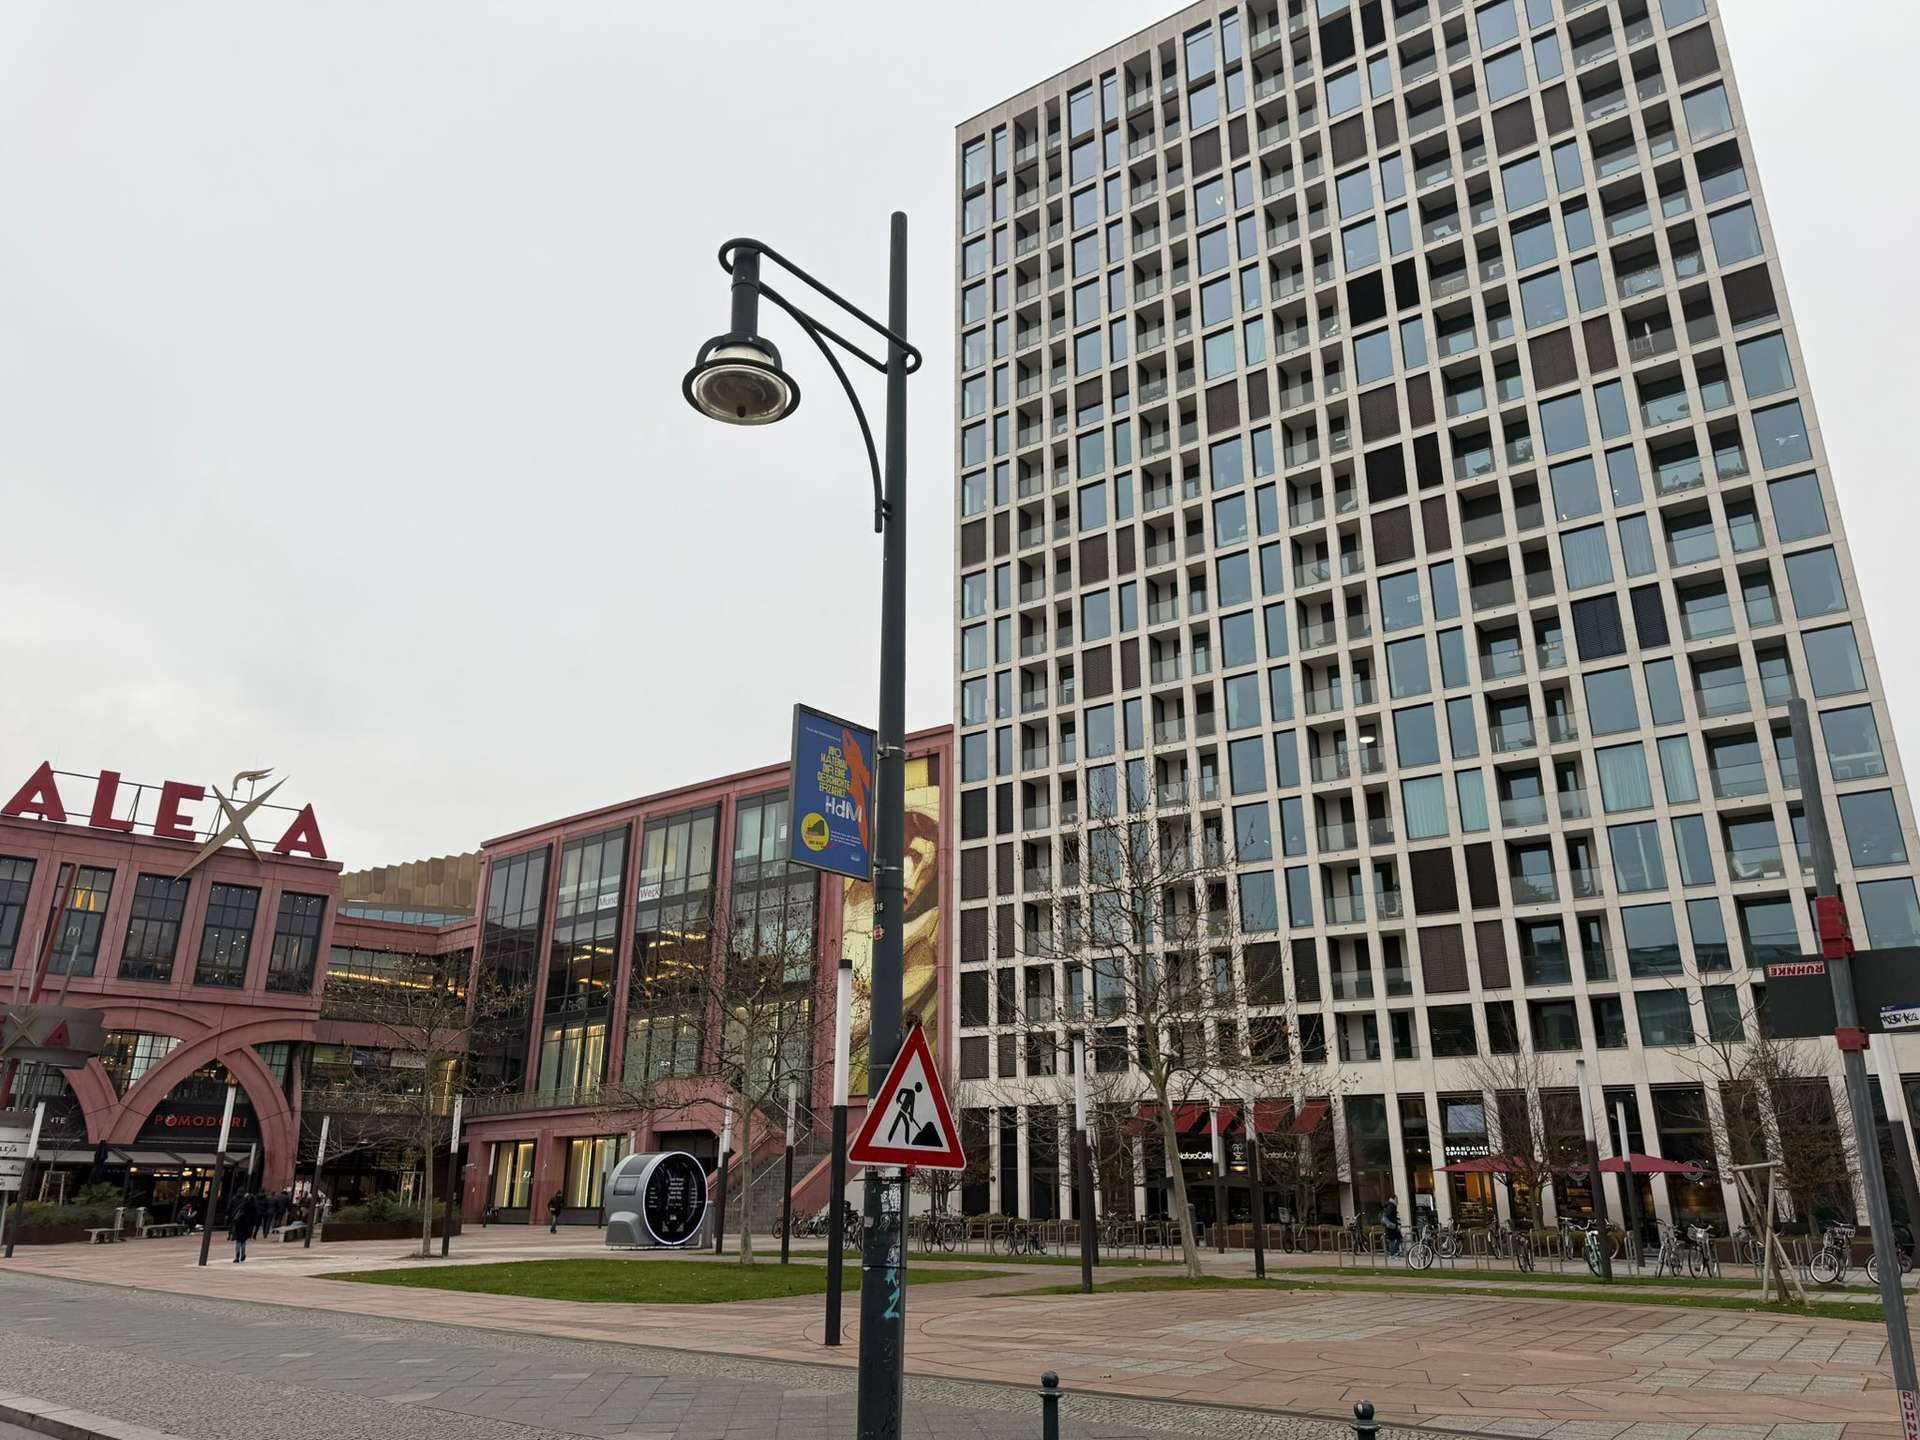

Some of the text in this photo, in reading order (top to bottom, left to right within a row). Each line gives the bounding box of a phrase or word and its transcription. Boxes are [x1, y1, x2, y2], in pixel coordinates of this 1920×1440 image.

[1, 760, 328, 881] ALEXA
[825, 795, 863, 823] HdM
[1769, 964, 1824, 976] RUHNKE
